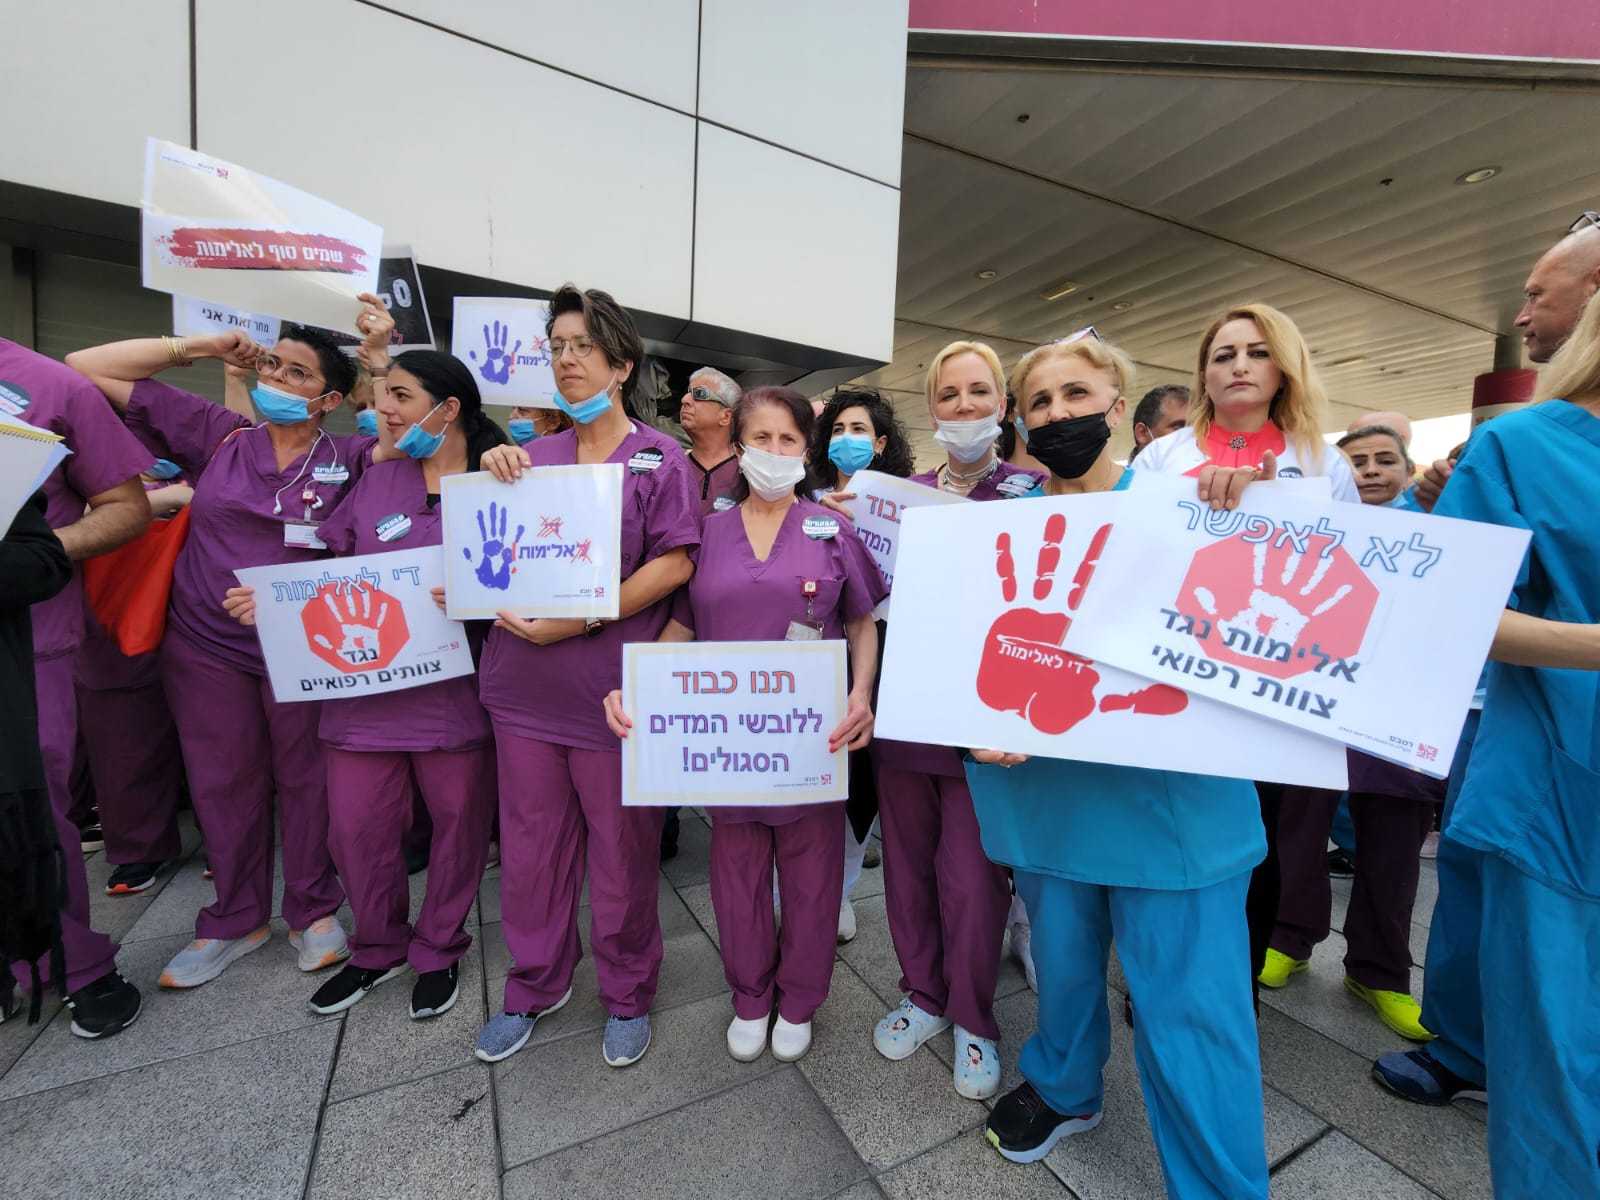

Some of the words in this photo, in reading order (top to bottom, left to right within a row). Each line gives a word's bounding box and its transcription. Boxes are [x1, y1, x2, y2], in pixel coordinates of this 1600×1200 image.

[194, 239, 264, 259] לאלימות
[268, 244, 296, 263] סוף
[303, 246, 343, 263] שמים
[202, 308, 223, 322] אני
[253, 321, 269, 333] מחר
[866, 494, 907, 524] בוד
[856, 527, 892, 555] המדי
[1177, 500, 1345, 559] לאפשר
[1360, 532, 1442, 578] לא
[271, 566, 381, 601] לאלימות
[393, 566, 420, 586] די
[1159, 607, 1211, 640] נגד
[343, 647, 378, 662] נגד
[998, 642, 1063, 669] לאלימות
[1223, 626, 1361, 683] אלימות
[377, 659, 442, 683] צוותים
[1068, 660, 1084, 675] די
[1151, 645, 1240, 690] רפואי
[300, 674, 370, 691] רפואיים
[672, 670, 738, 694] כבוד
[750, 670, 796, 694] תנו
[1252, 676, 1337, 719] צוות
[650, 713, 728, 734] המדים
[739, 707, 823, 734] ללובשי
[682, 746, 790, 773] הסגולים!
